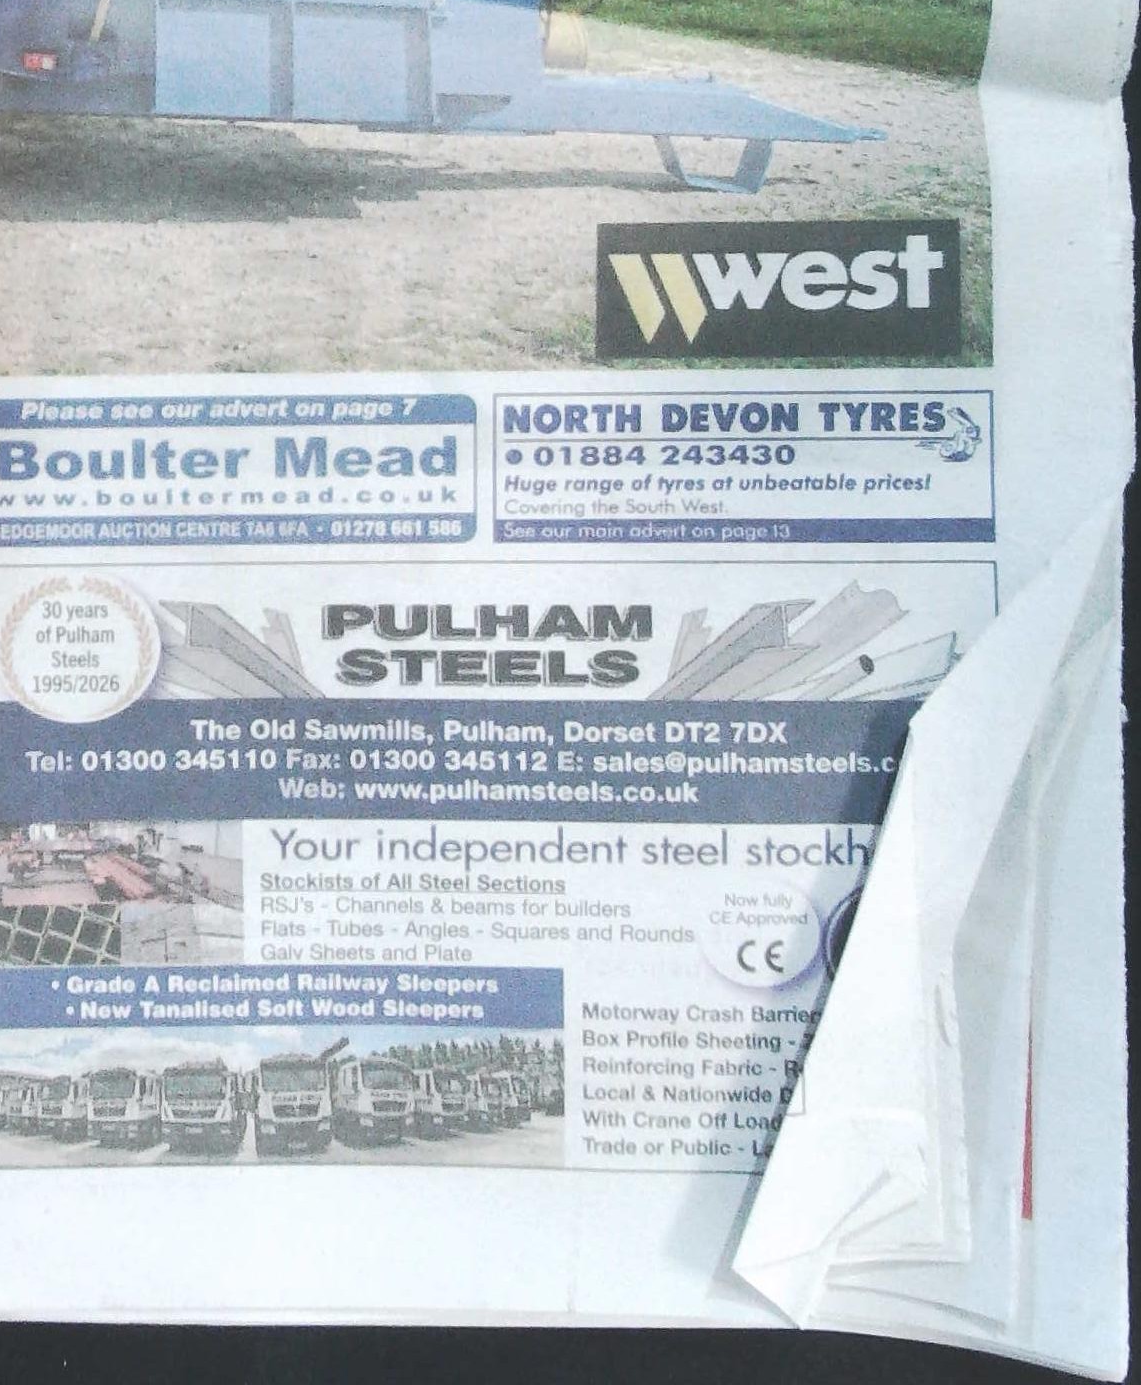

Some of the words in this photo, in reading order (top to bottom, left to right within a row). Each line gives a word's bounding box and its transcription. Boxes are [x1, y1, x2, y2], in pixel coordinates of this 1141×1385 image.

[692, 234, 944, 311] west
[503, 403, 642, 435] NORTH
[661, 402, 799, 434] DEVON
[818, 401, 946, 432] TYRES
[274, 435, 457, 478] Mead
[533, 444, 647, 467] 01884
[660, 443, 796, 466] 243430
[503, 474, 558, 495] Huge
[564, 478, 624, 495] range
[630, 473, 653, 491] of
[657, 475, 705, 495] tyres
[711, 475, 733, 491] at
[738, 472, 857, 492] unbeatable
[862, 473, 932, 494] prices!
[321, 603, 654, 641] PULHAM
[51, 650, 101, 669] Steels
[335, 649, 641, 686] STEELS
[32, 675, 120, 695] 1995/2026
[189, 719, 242, 741] The
[250, 718, 295, 741] Old
[304, 718, 434, 745] Sawmills,
[443, 718, 555, 746] Pulham,
[563, 720, 657, 744] Dorset
[664, 721, 721, 744] DT2
[730, 721, 788, 745] 7DX
[24, 750, 73, 773] Tel:
[80, 750, 167, 773] 01300
[173, 748, 277, 772] 345110
[285, 748, 342, 770] Fax:
[349, 749, 436, 771] 01300
[444, 750, 548, 773] 345112
[277, 777, 345, 801] Web:
[354, 779, 700, 804] www.pulhamsteels.co.uk
[270, 827, 361, 861] Your
[376, 824, 628, 872] independent
[641, 828, 729, 867] steel
[260, 872, 354, 891] Stockists
[360, 872, 381, 890] of
[386, 873, 412, 890] All
[418, 874, 471, 892] Steel
[476, 875, 567, 894] Sections
[67, 975, 136, 995] Grade
[143, 975, 160, 995] A
[166, 974, 290, 995] Reclaimed
[297, 973, 390, 999] Railway
[395, 973, 499, 999] Sleepers
[81, 1000, 134, 1020] New
[138, 999, 250, 1019] Tanalised
[257, 998, 303, 1018] Soft
[309, 998, 376, 1018] Wood
[382, 998, 485, 1023] Sleepers
[581, 1002, 680, 1025] Motorway
[685, 1004, 744, 1024] Crash
[581, 1029, 619, 1048] Box
[626, 1029, 689, 1049] Profile
[695, 1032, 782, 1055] Sheeting
[582, 1083, 636, 1102] Local
[662, 1086, 773, 1104] Nationwide
